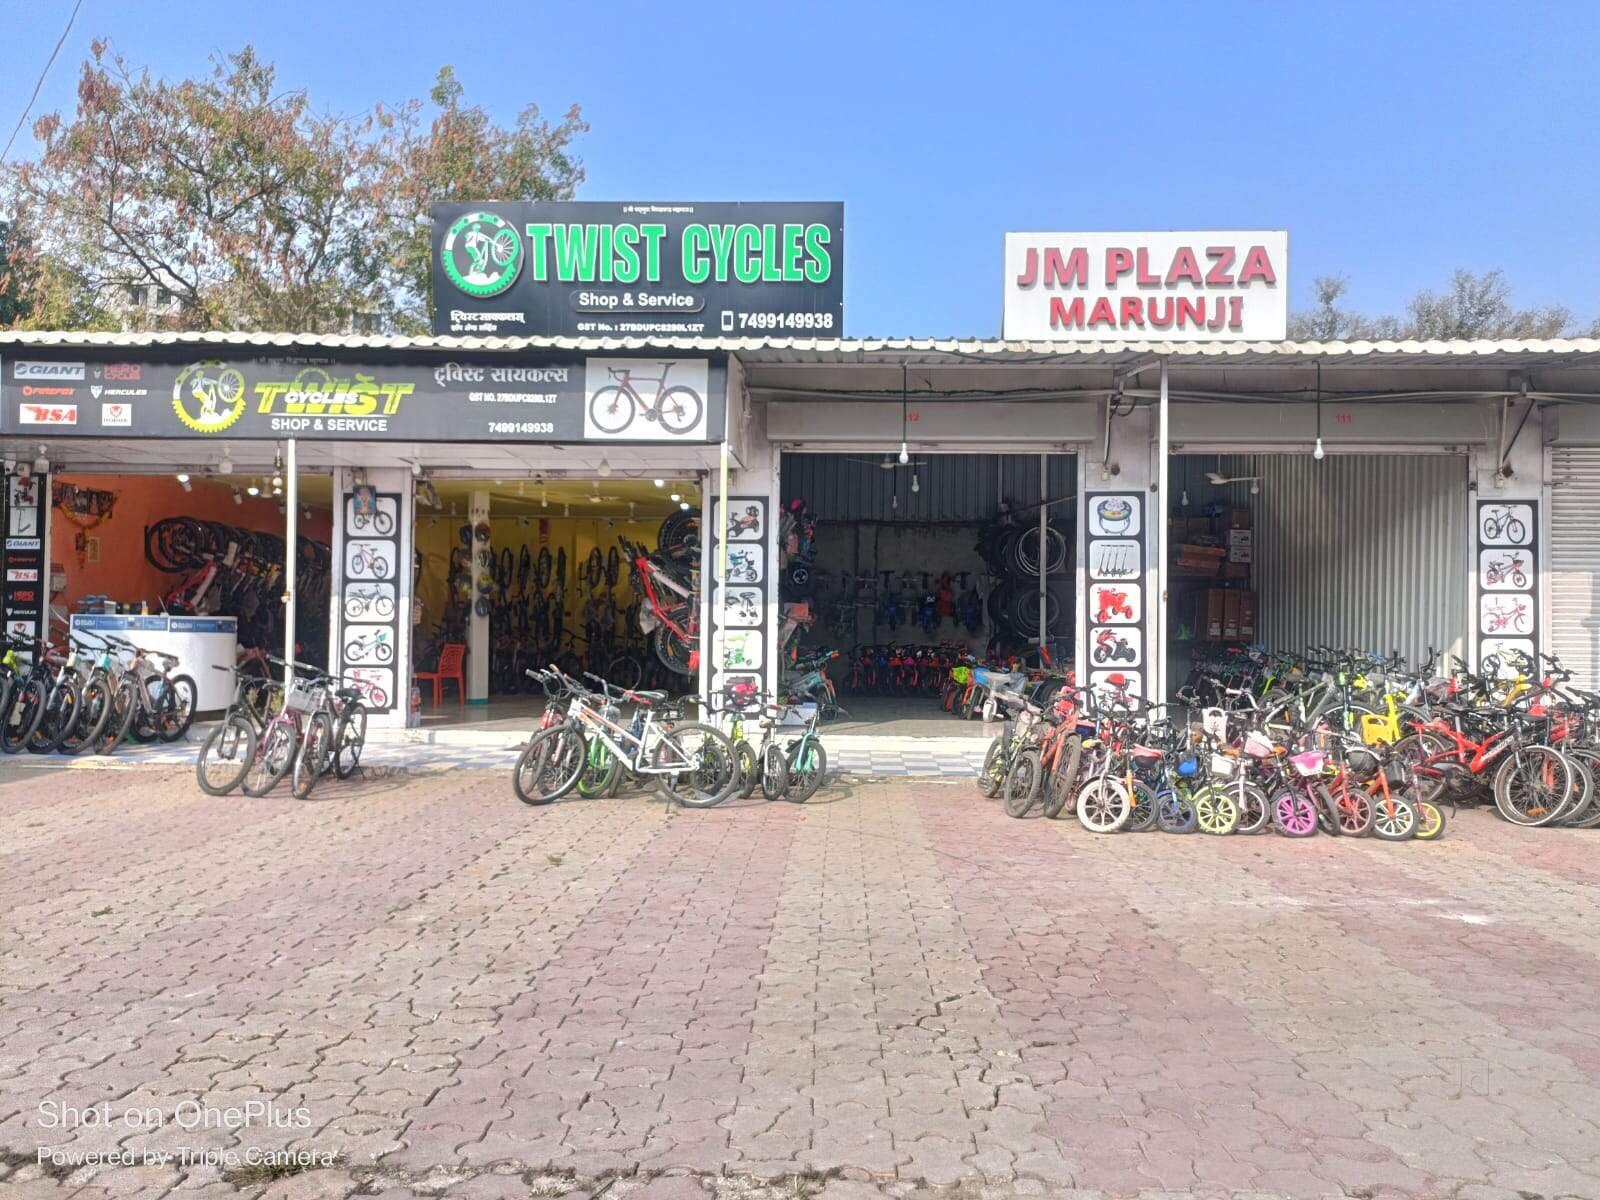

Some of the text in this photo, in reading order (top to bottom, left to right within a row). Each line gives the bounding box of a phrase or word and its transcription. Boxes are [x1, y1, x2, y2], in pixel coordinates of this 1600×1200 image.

[526, 223, 832, 284] TWIST CYCLES
[1017, 245, 1277, 287] JM PLAZA
[579, 293, 694, 309] Shop & Service
[1049, 296, 1245, 328] MARUNJI
[577, 323, 596, 331] GST
[738, 313, 833, 330] 7499149938
[29, 364, 84, 375] GIANT
[104, 363, 141, 372] HERO
[284, 391, 358, 405] CYCLES
[469, 392, 483, 402] GST
[33, 408, 76, 422] BSA
[271, 419, 388, 432] SHOP & SERVICE
[488, 422, 554, 433] 7499149938
